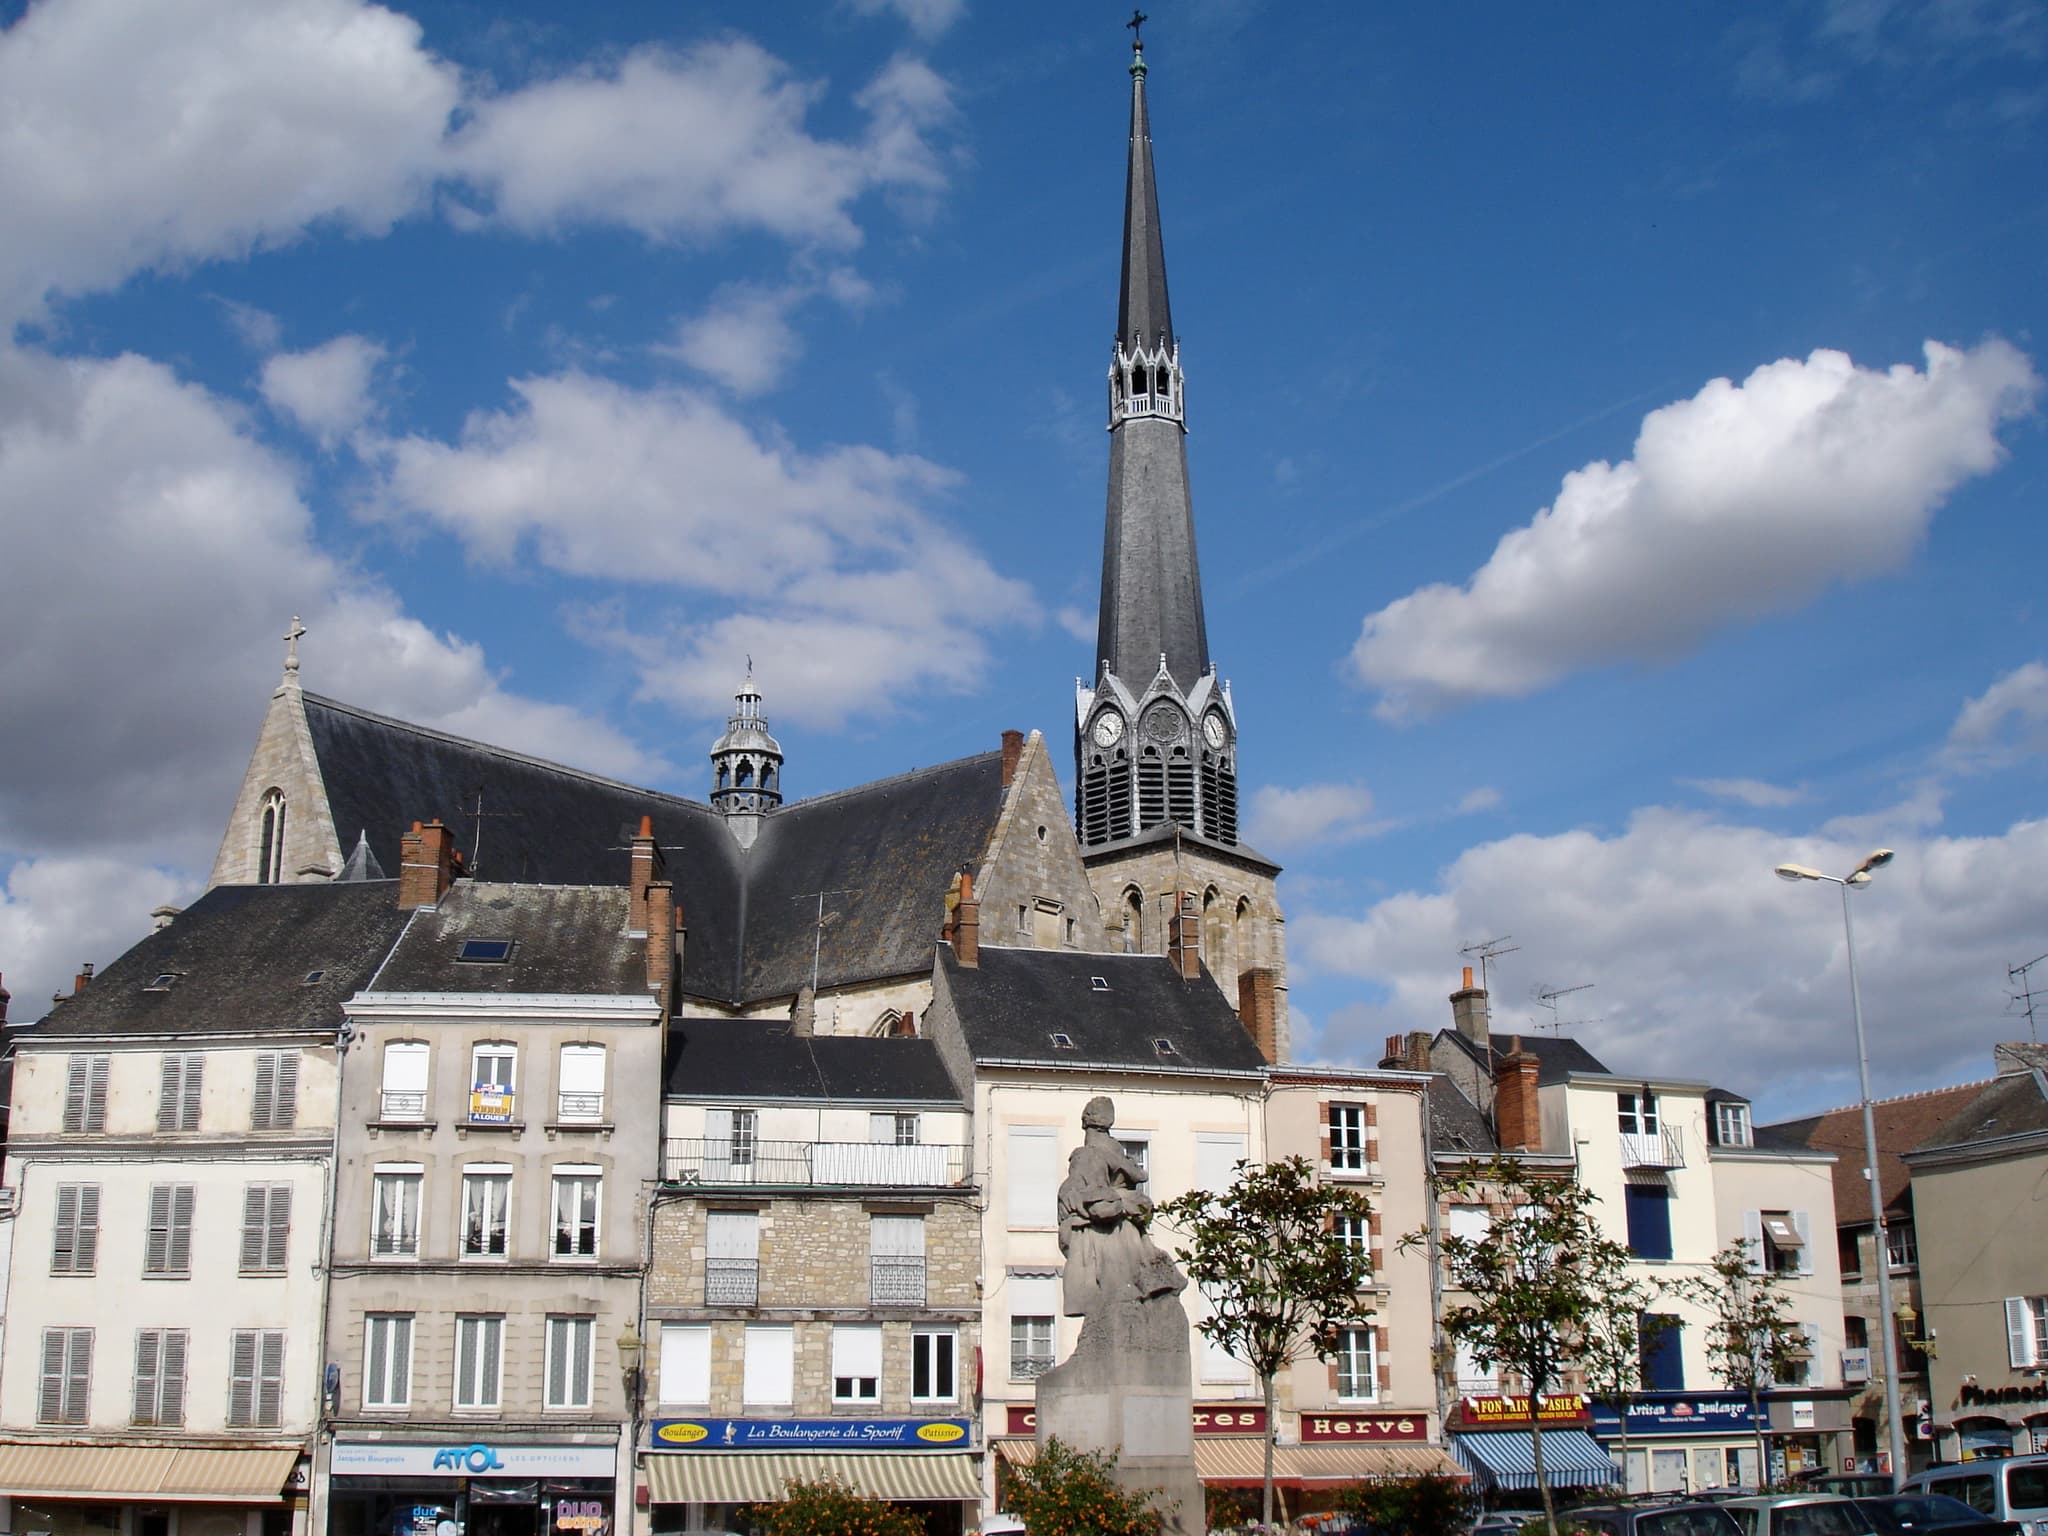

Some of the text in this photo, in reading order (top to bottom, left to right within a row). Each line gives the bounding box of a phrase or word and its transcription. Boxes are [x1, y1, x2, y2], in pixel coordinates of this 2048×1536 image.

[1627, 1401, 1748, 1418] Artisan Boulanger
[1193, 1413, 1256, 1426] res
[1313, 1417, 1415, 1434] Hervé
[663, 1426, 705, 1439] Boulanger
[747, 1424, 907, 1441] La Boulangerie du Sportif
[433, 1443, 505, 1473] ATOL
[287, 1471, 306, 1484] es
[412, 1505, 438, 1516] duo
[557, 1501, 602, 1518] DUO
